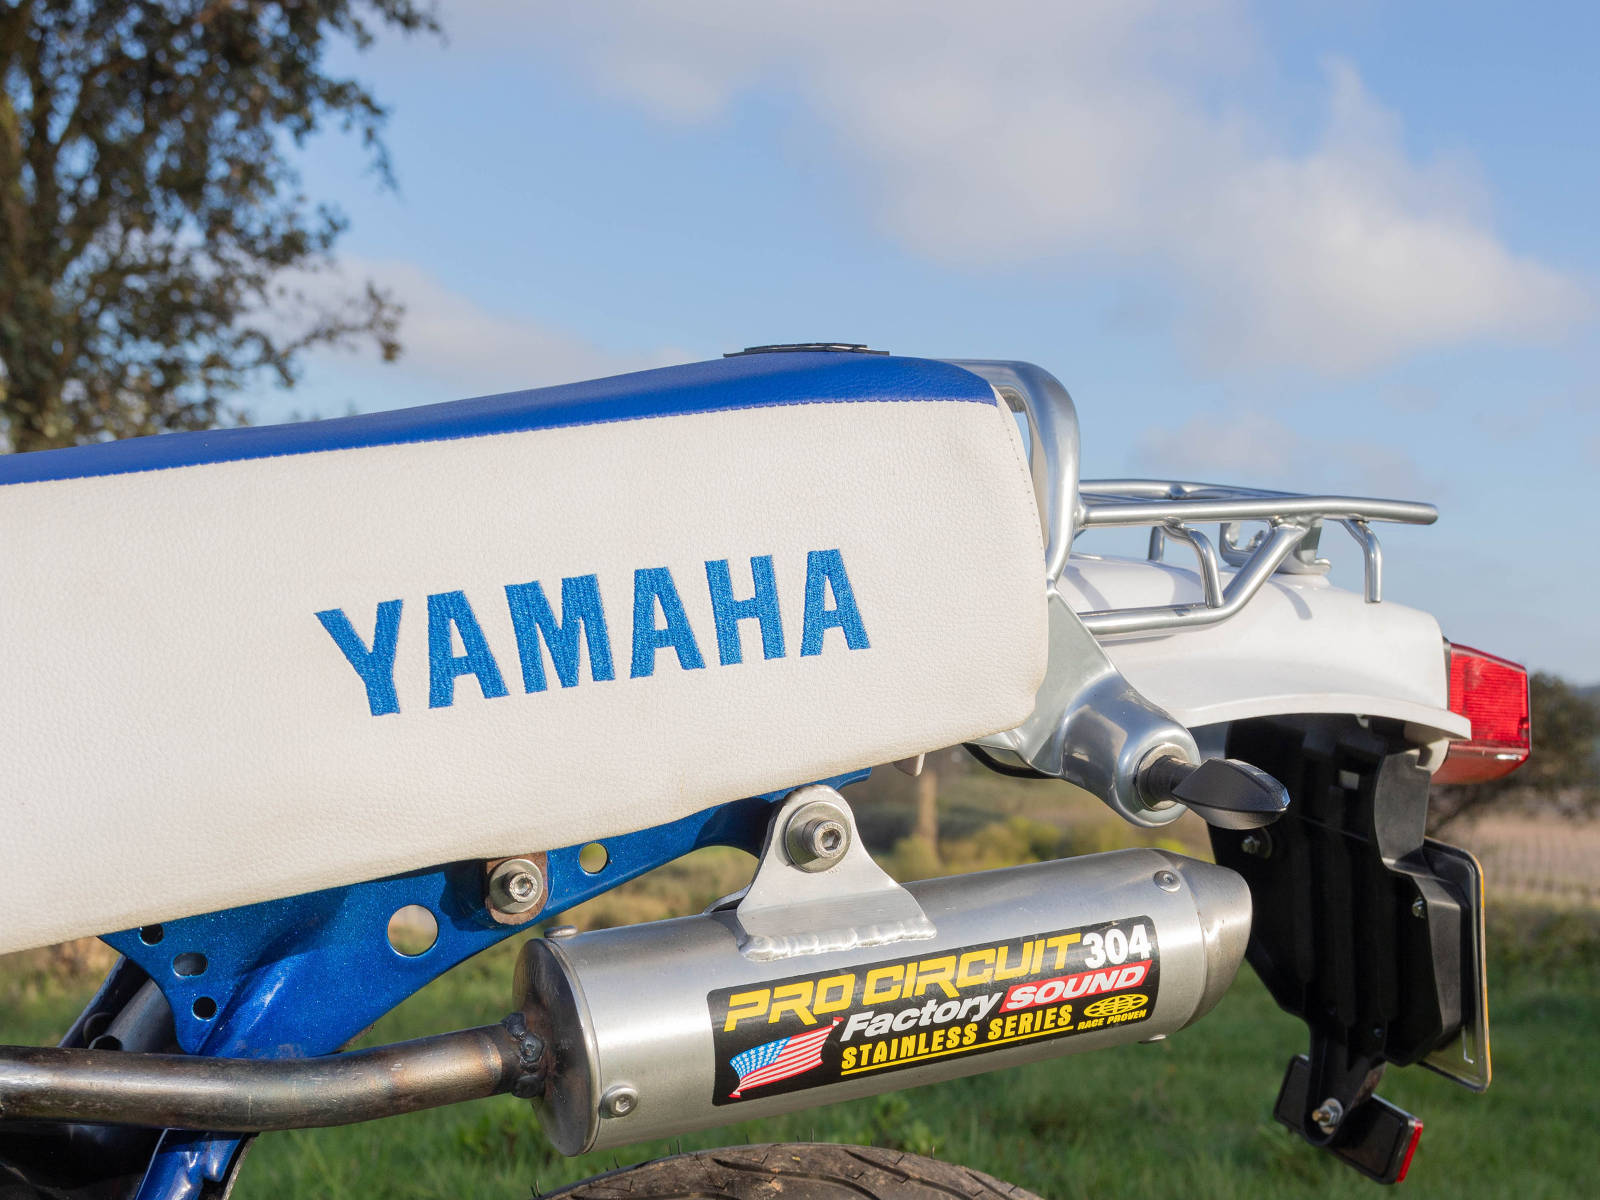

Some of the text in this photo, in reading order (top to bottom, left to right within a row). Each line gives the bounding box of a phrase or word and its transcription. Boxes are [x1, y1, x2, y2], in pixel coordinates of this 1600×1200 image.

[313, 548, 871, 716] YAMAHA
[724, 924, 1152, 1032] PRO CIRCUIT 304
[840, 965, 1147, 1042] Factory SOUND
[841, 1004, 1072, 1069] STAINLESS SERIES
[1077, 1009, 1147, 1031] RACE PROVEN
